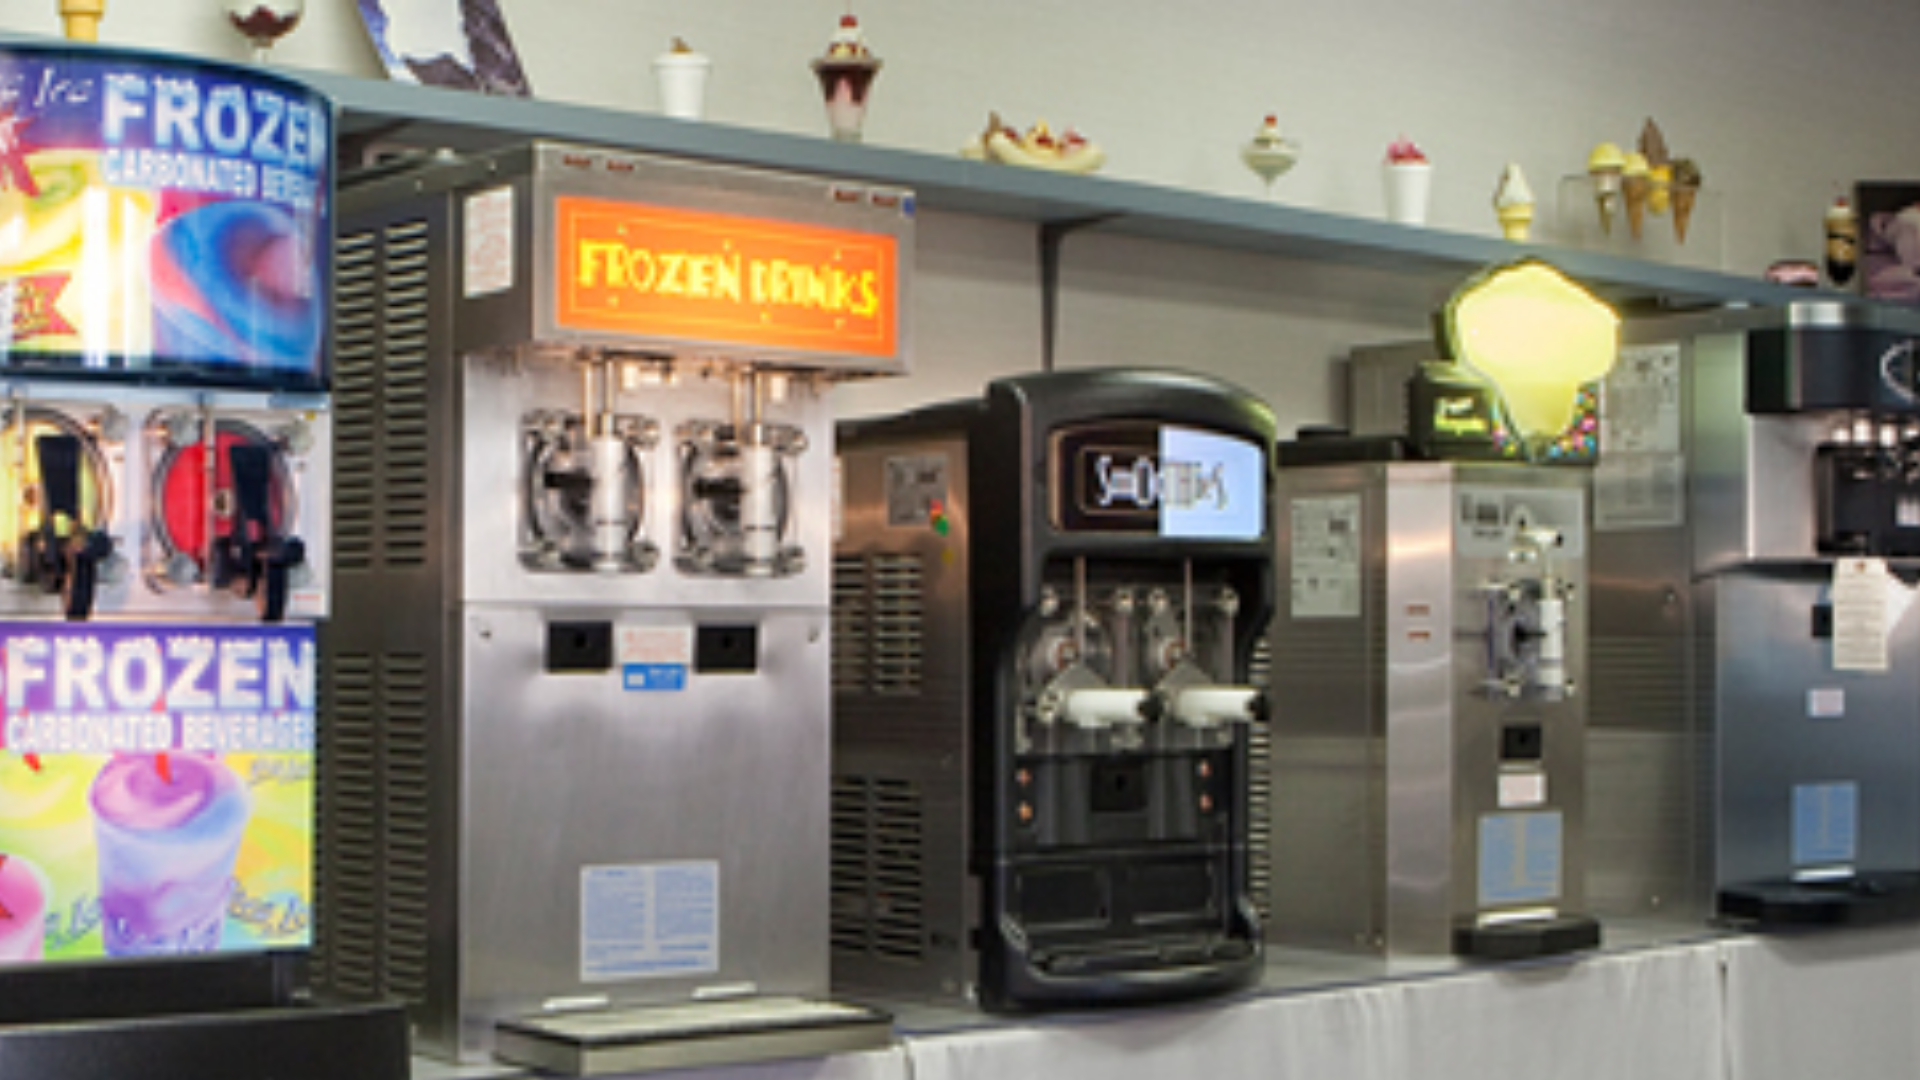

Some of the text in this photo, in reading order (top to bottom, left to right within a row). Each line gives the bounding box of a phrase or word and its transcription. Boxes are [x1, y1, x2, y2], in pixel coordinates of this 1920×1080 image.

[100, 148, 255, 197] CARBONATED
[578, 239, 741, 304] FROZEN
[749, 258, 878, 319] DRINKS
[5, 635, 314, 709] FROZEN
[6, 712, 173, 752] CARBONATED
